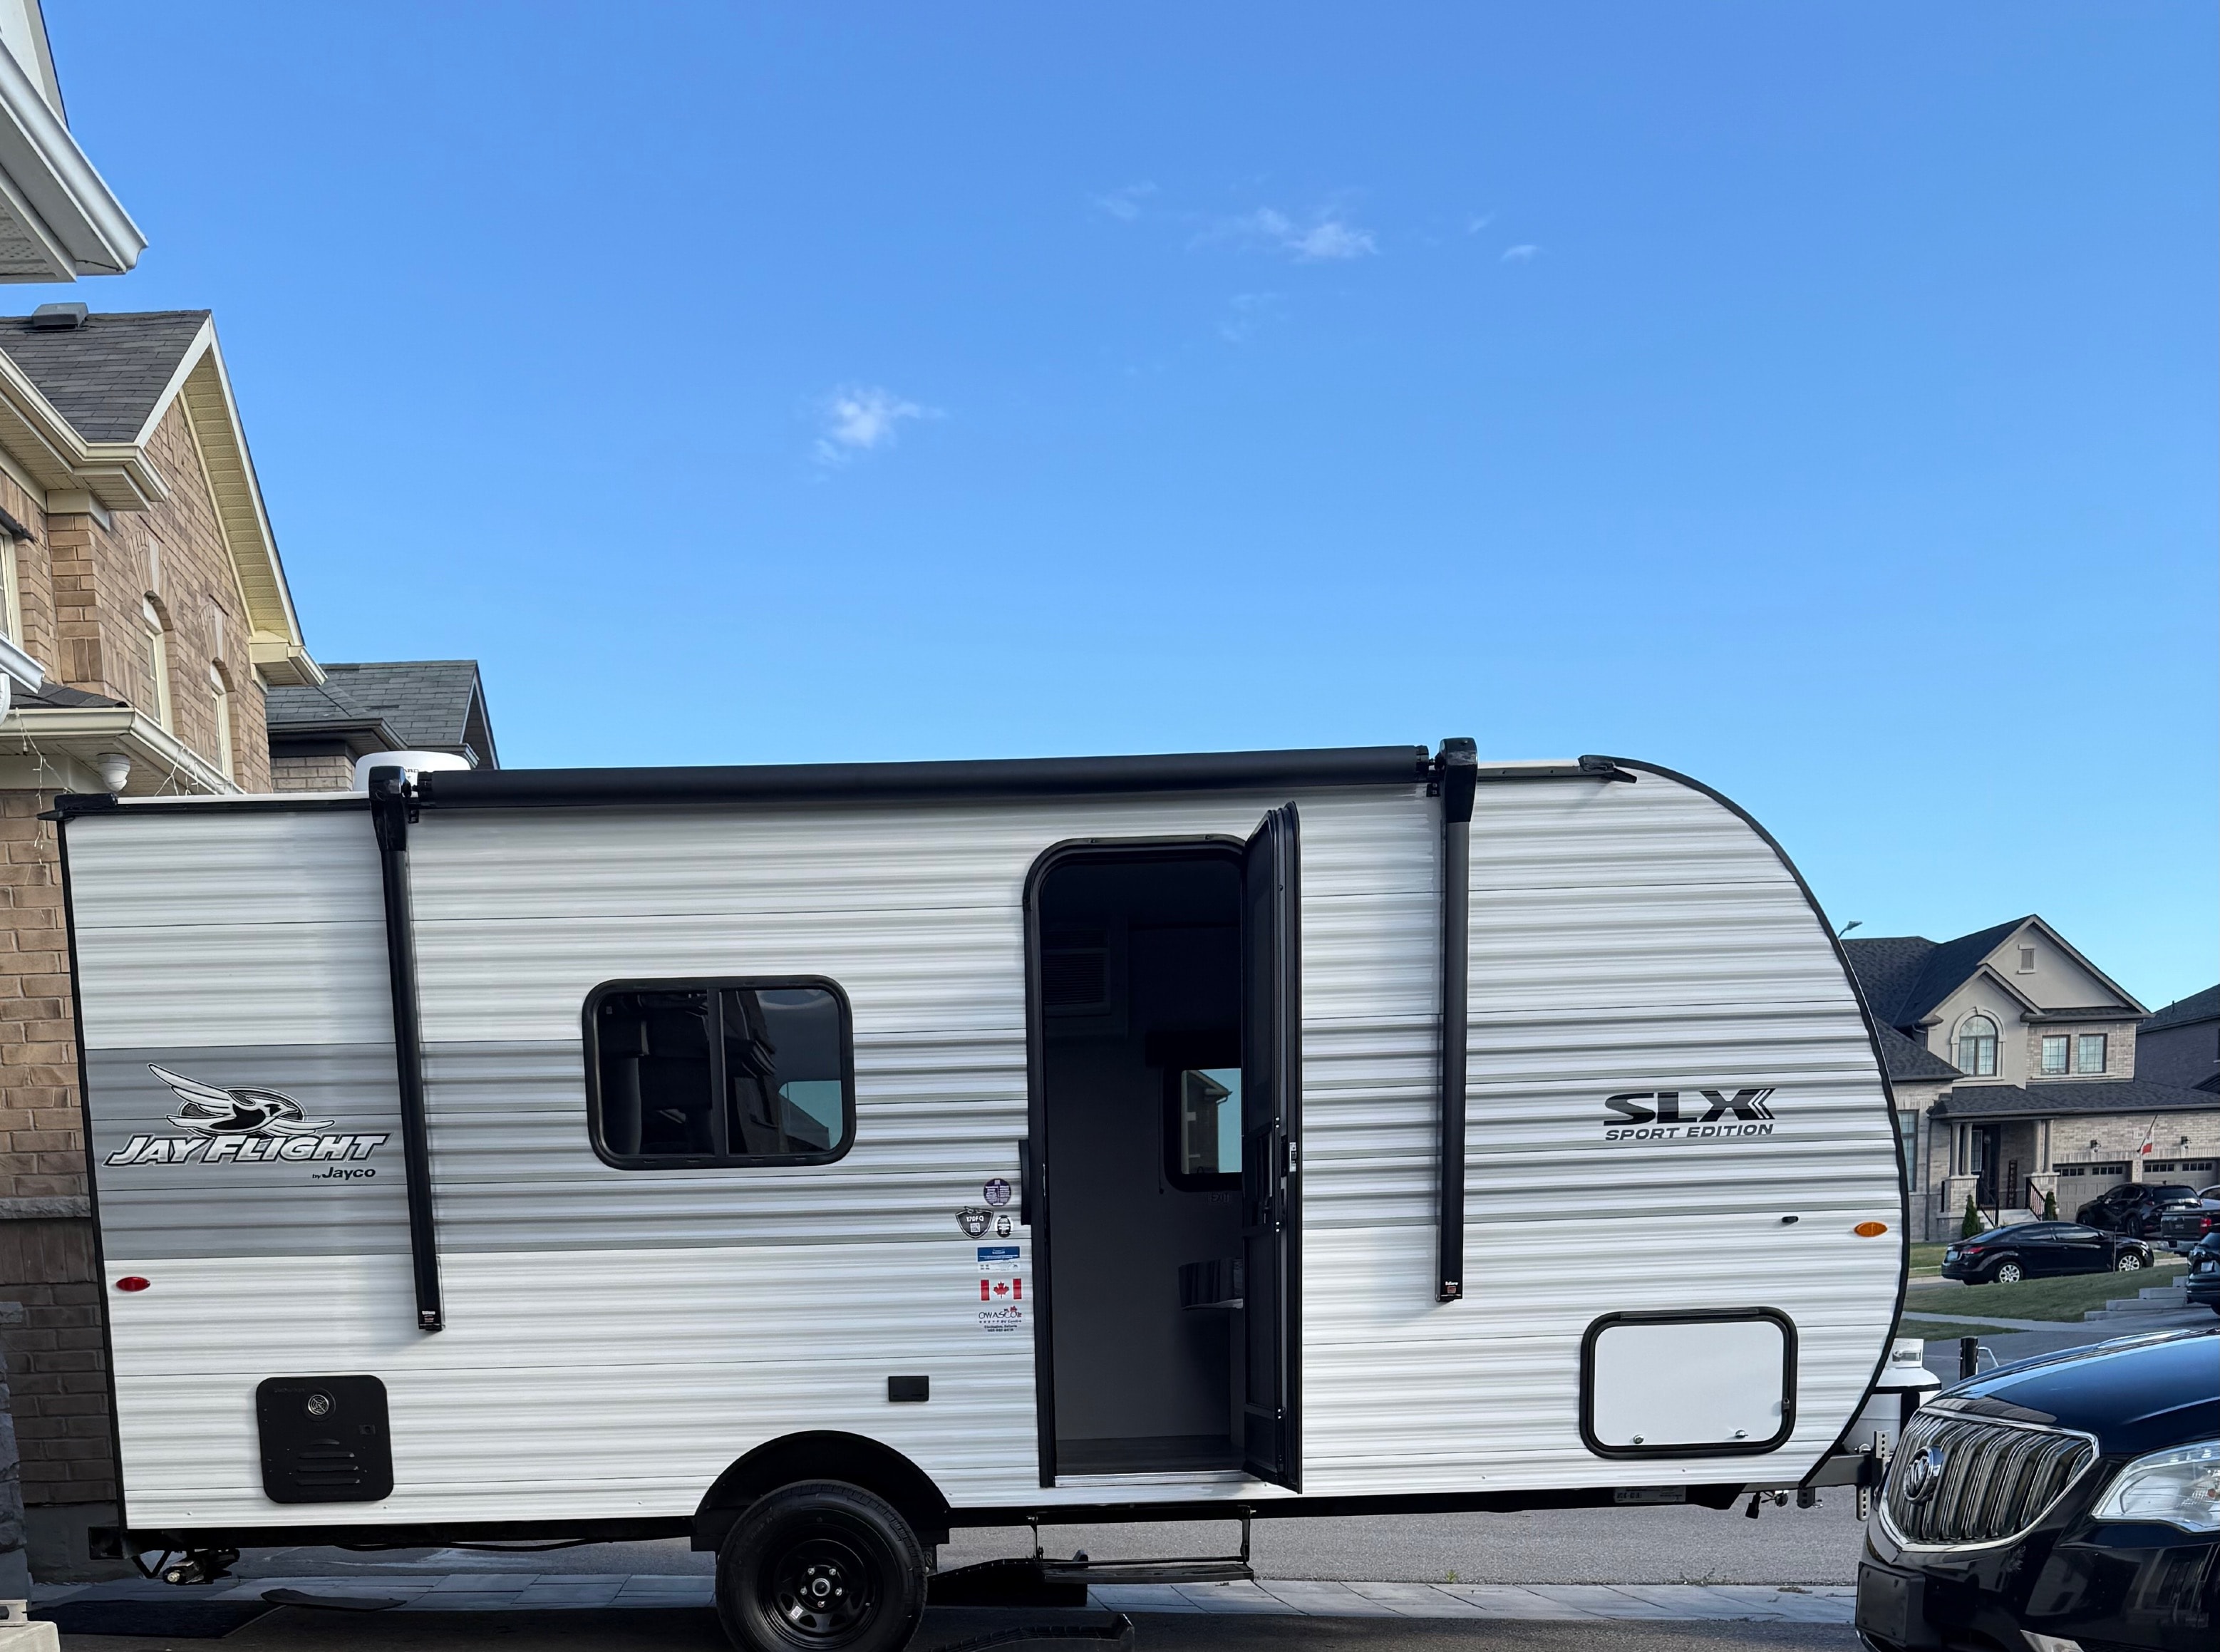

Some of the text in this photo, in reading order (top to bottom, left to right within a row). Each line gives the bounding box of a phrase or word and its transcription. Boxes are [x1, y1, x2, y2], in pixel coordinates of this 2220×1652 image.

[1604, 1088, 1776, 1126] SLX
[1605, 1124, 1774, 1141] SPORT EDITION
[104, 1132, 391, 1166] JAY FLIGHT
[321, 1167, 376, 1181] Jayco
